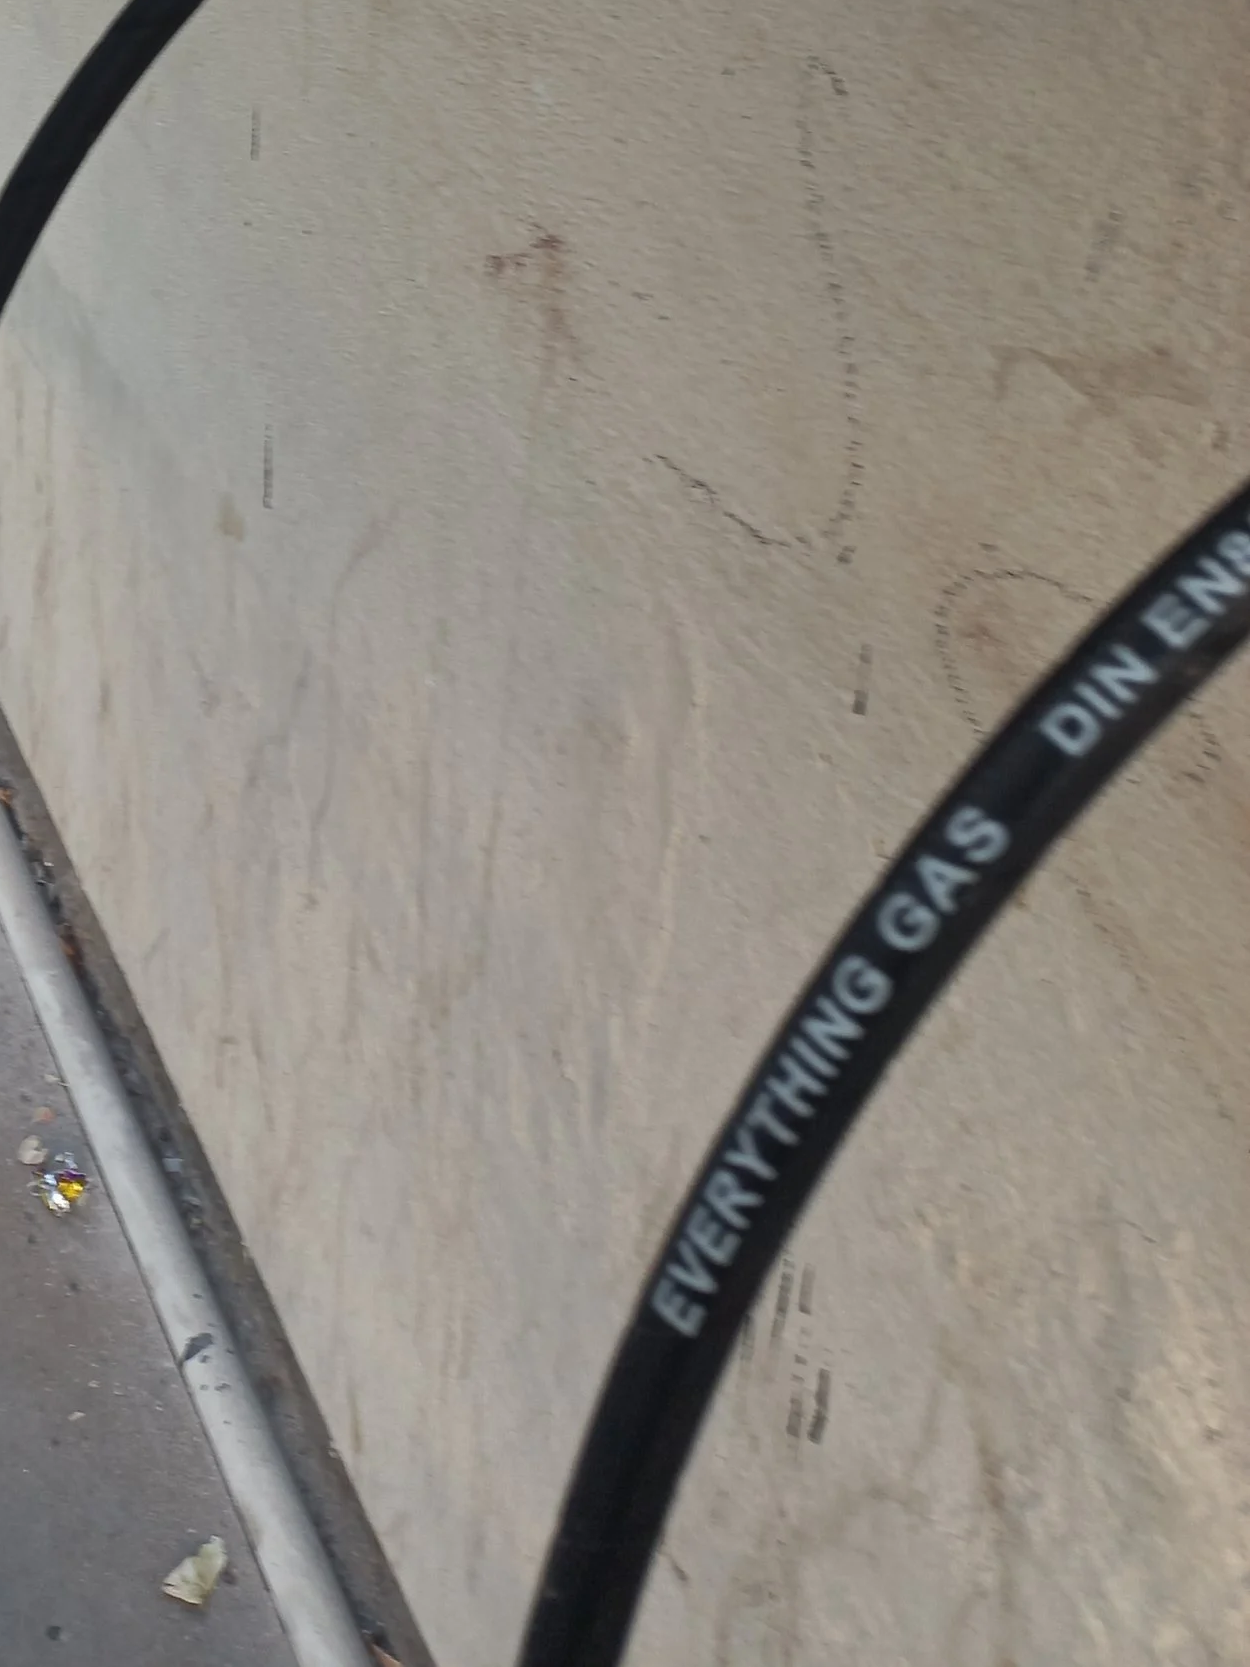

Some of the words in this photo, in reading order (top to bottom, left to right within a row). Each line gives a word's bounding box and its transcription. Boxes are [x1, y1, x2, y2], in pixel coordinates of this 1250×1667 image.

[650, 954, 894, 1339] EVERYTHING
[877, 805, 1012, 953] GAS
[1039, 642, 1159, 758] DIN
[1141, 512, 1250, 650] EN8
